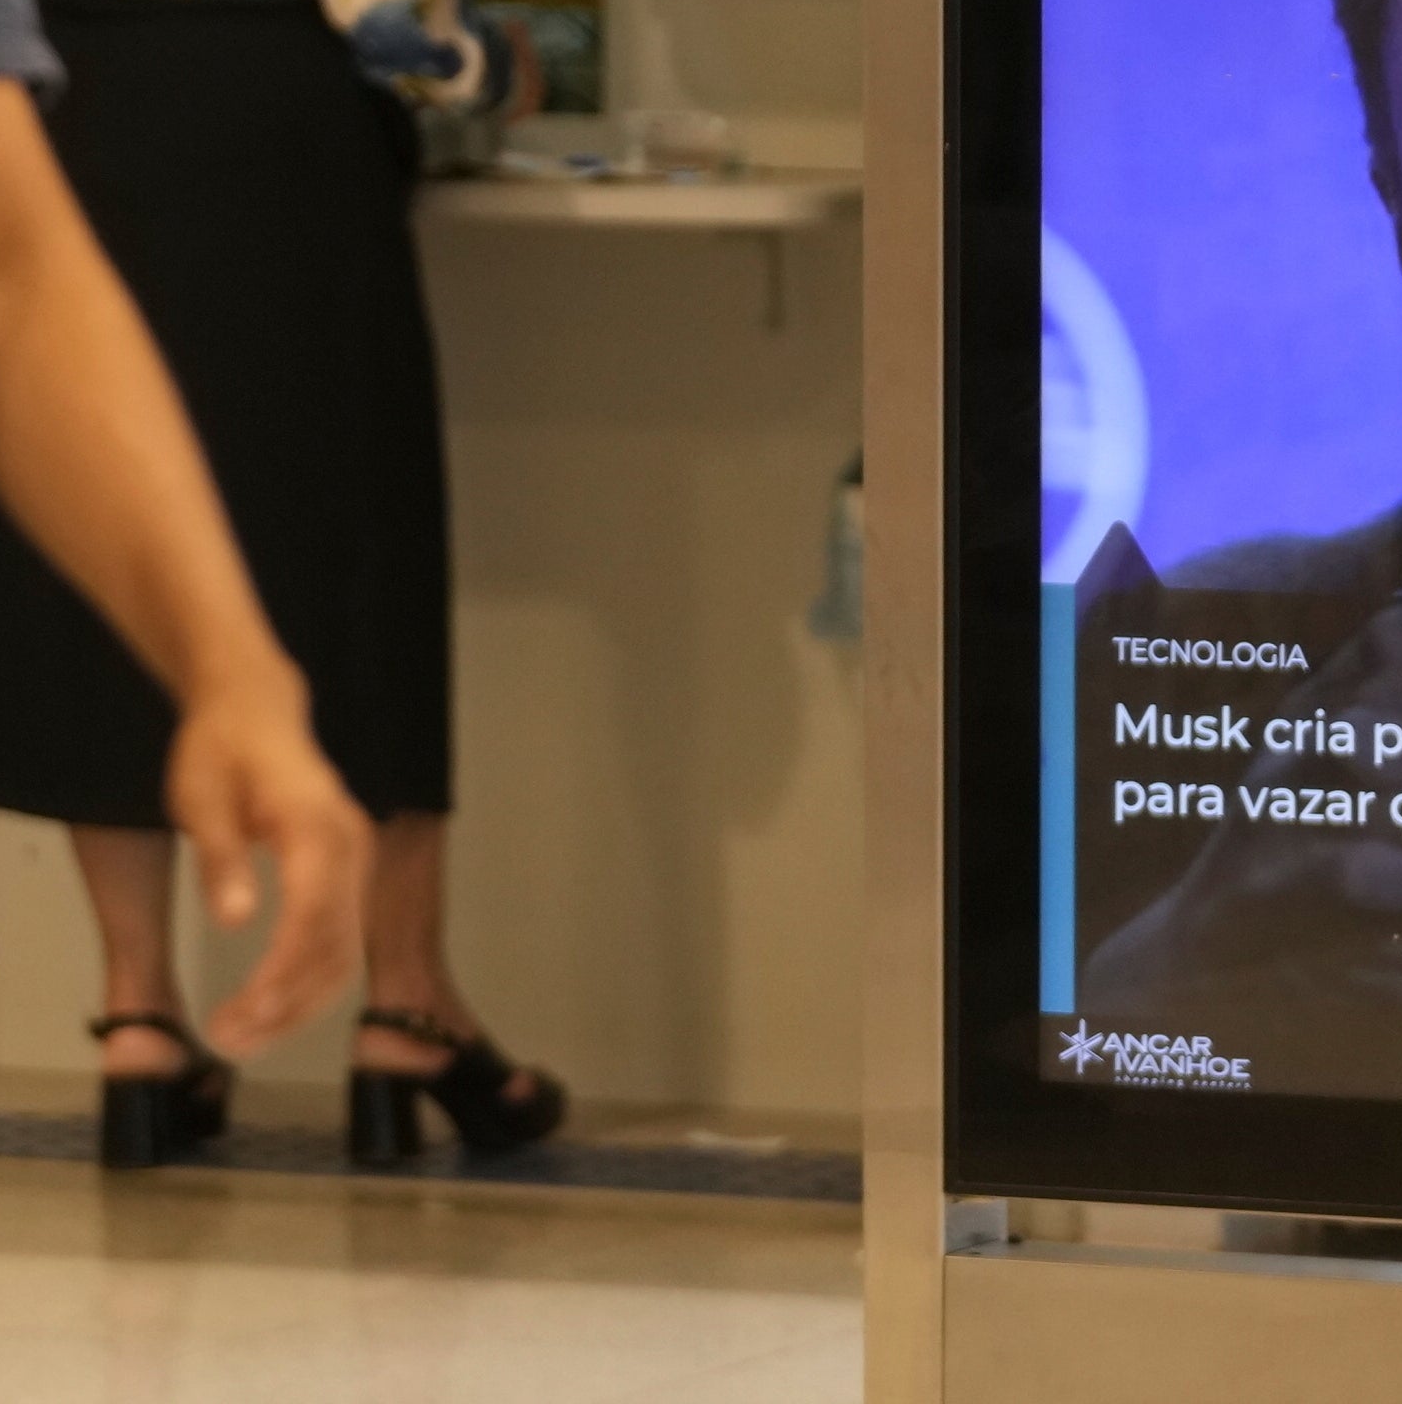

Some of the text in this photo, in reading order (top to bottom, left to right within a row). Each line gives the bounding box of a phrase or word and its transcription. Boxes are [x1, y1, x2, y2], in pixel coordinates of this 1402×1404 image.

[1112, 635, 1310, 671] TECNOLOGIA
[1114, 701, 1252, 751] Musk
[1262, 707, 1357, 756] cria
[1114, 779, 1225, 824] para
[1238, 785, 1377, 826] vazar
[1101, 1031, 1213, 1057] ANCAR
[1114, 1051, 1253, 1078] IVANHOE
